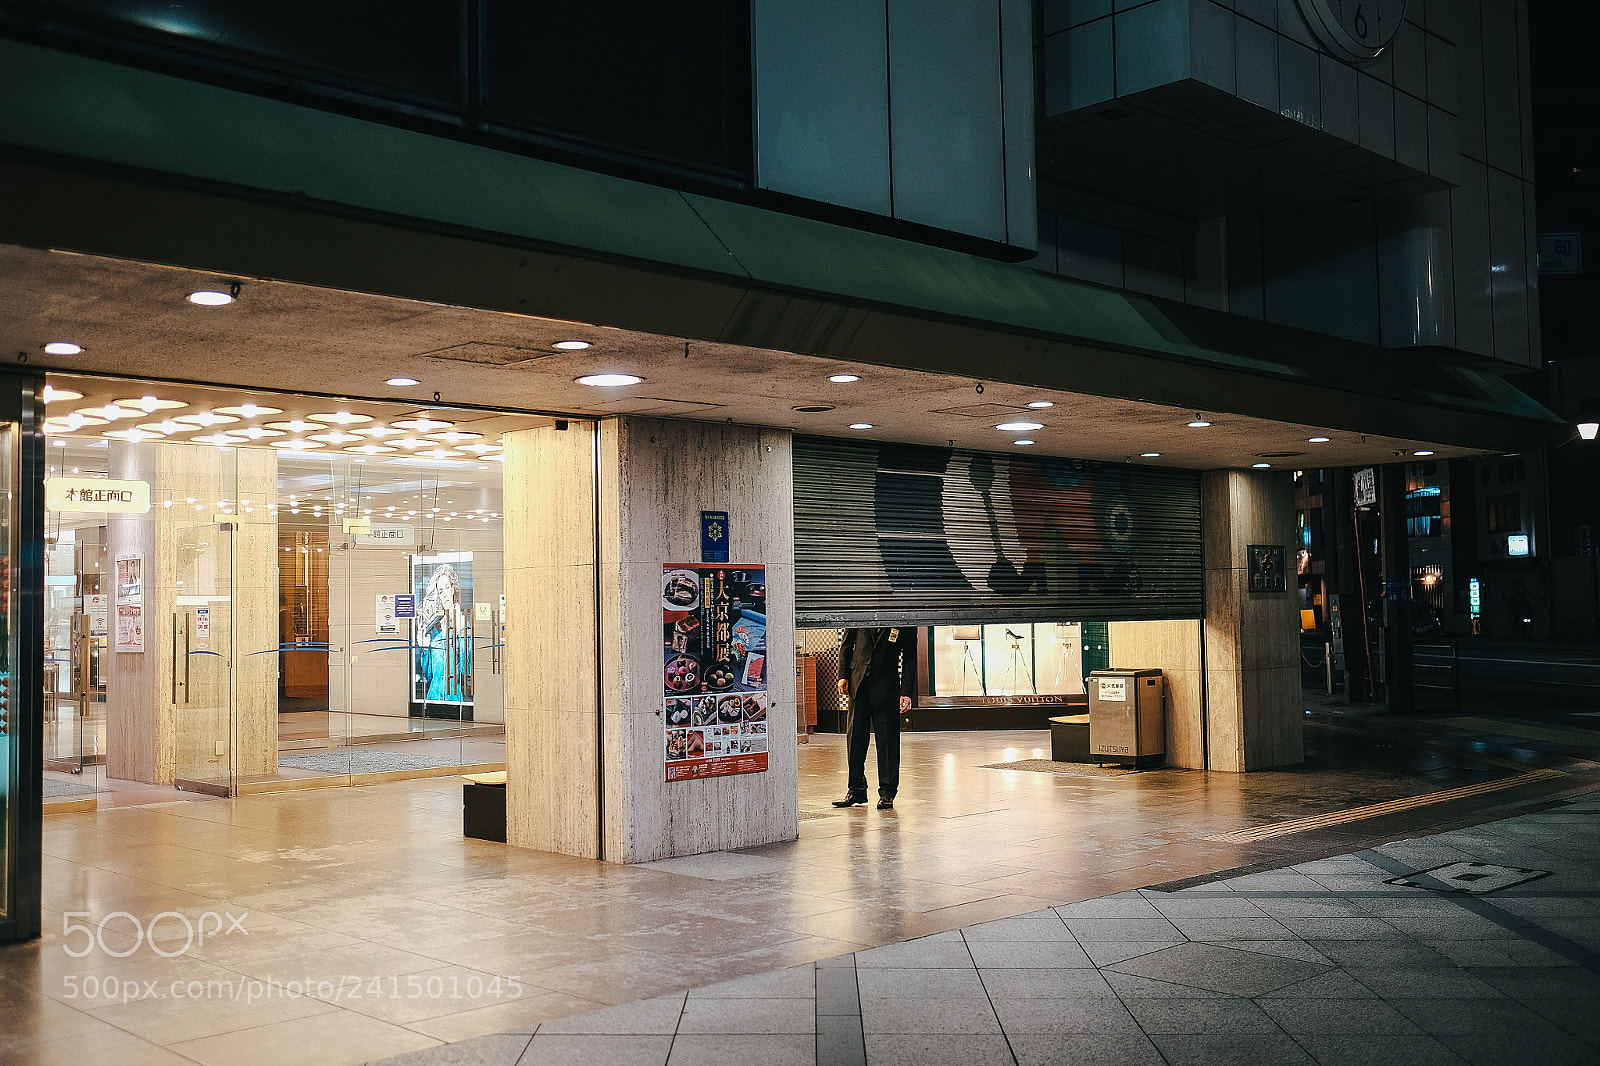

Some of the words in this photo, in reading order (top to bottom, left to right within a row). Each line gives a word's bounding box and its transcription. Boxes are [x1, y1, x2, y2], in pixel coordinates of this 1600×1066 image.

[1354, 3, 1368, 39] 6
[65, 487, 133, 502] 本館正面口
[715, 581, 731, 663] 大京都展
[1016, 695, 1063, 703] VUITTON
